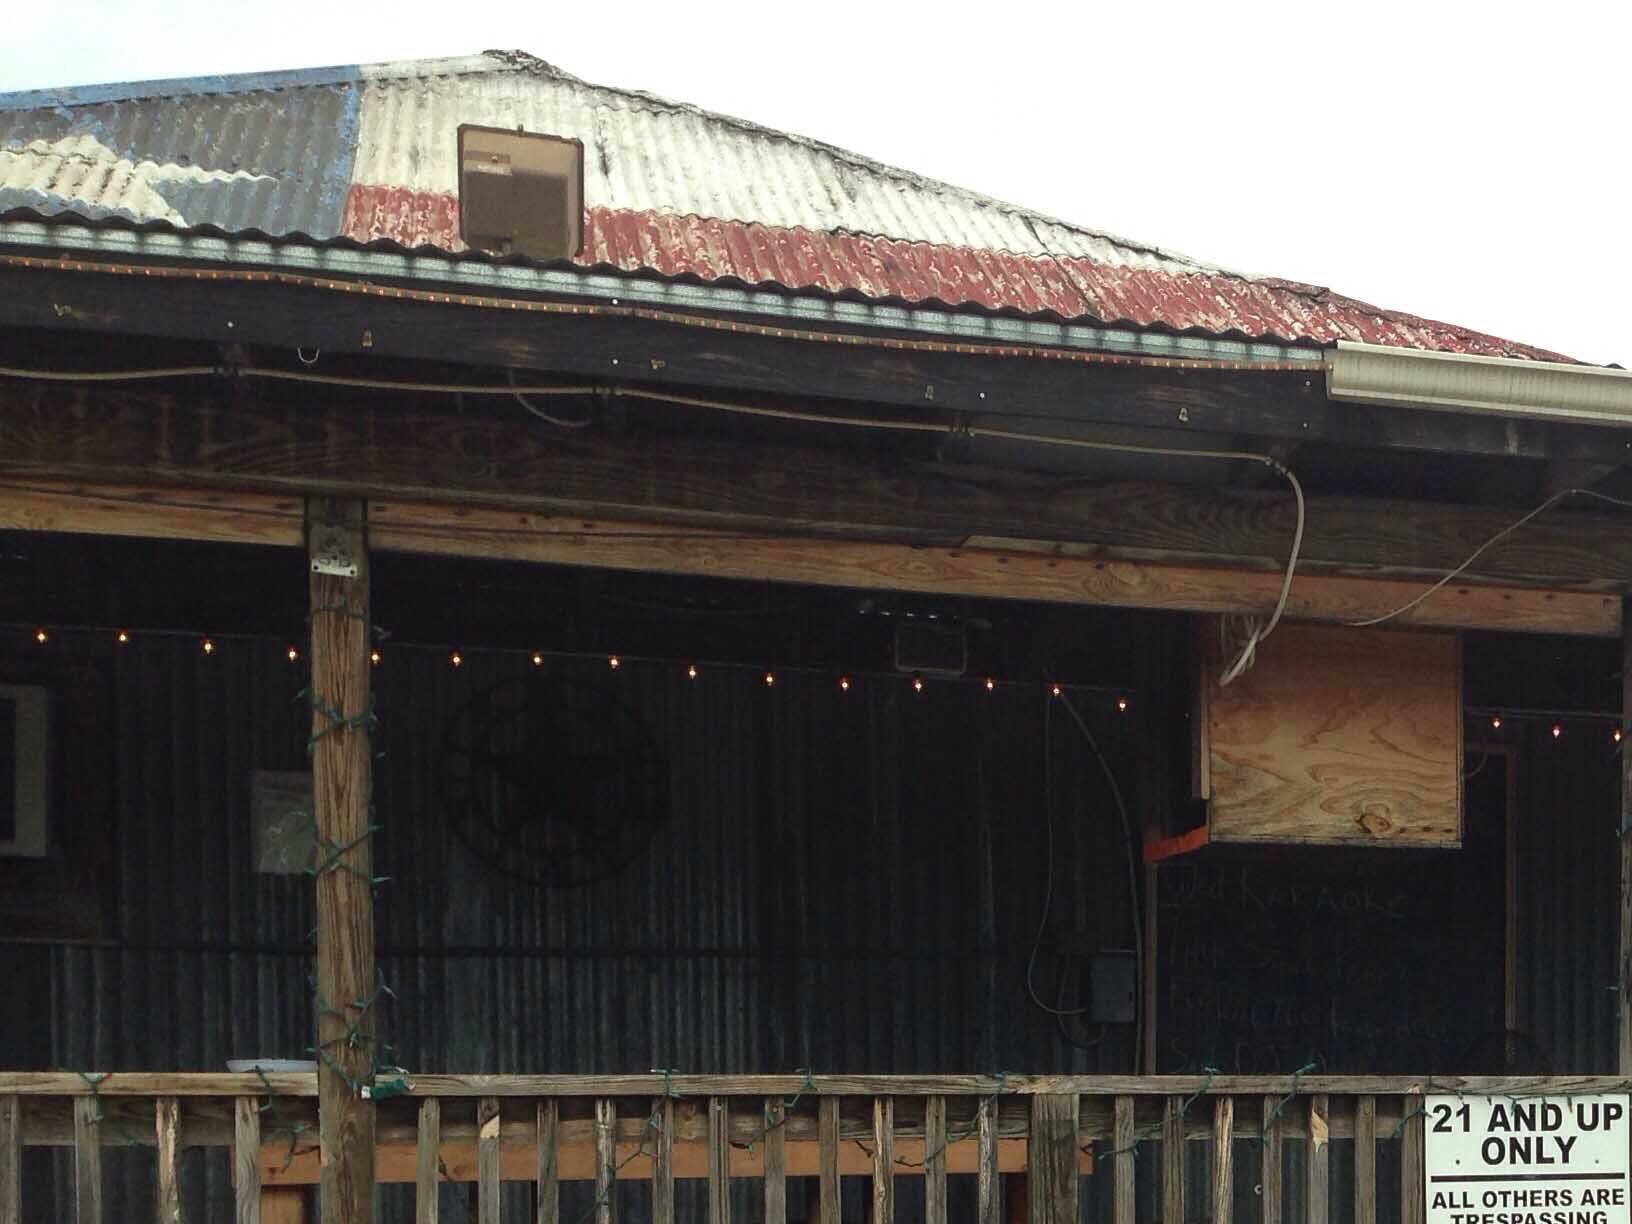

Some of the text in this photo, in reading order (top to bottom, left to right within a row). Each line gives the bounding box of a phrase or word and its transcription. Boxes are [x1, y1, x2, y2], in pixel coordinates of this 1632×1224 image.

[1432, 1103, 1623, 1133] 21 AND UP
[1481, 1135, 1577, 1165] ONLY
[1432, 1188, 1625, 1209] ALL OTHERS ARE
